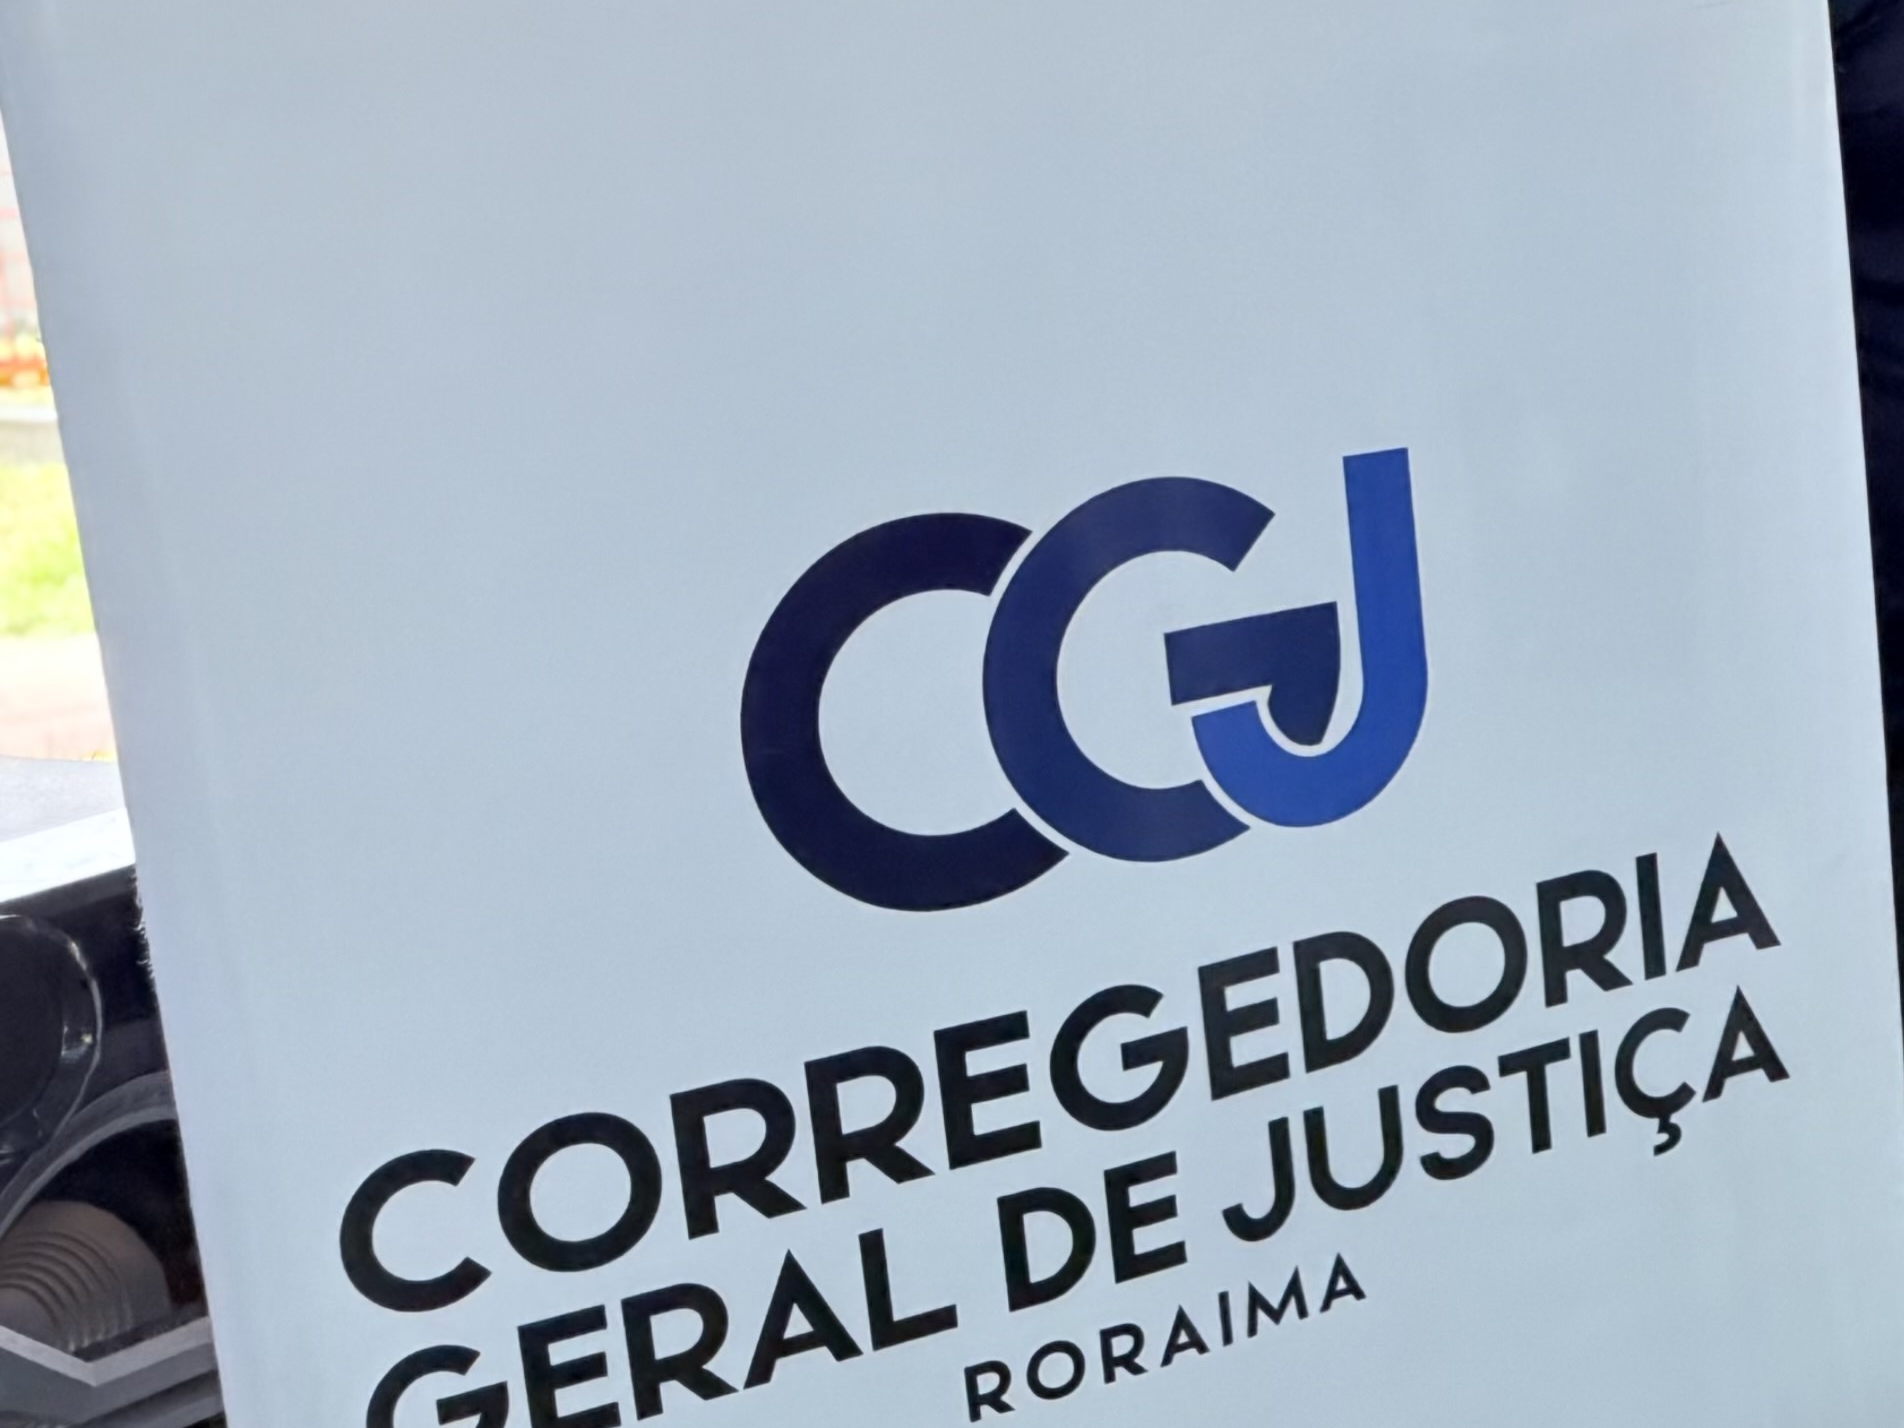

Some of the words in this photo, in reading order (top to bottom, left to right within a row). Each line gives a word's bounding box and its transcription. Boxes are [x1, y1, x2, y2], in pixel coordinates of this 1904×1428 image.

[740, 448, 1428, 912] CGJ
[340, 833, 1781, 1313] CORREGEDORIA
[997, 1151, 1187, 1313] DE
[1222, 986, 1790, 1243] JUSTIÇA
[964, 1253, 1367, 1423] RORAIMA
